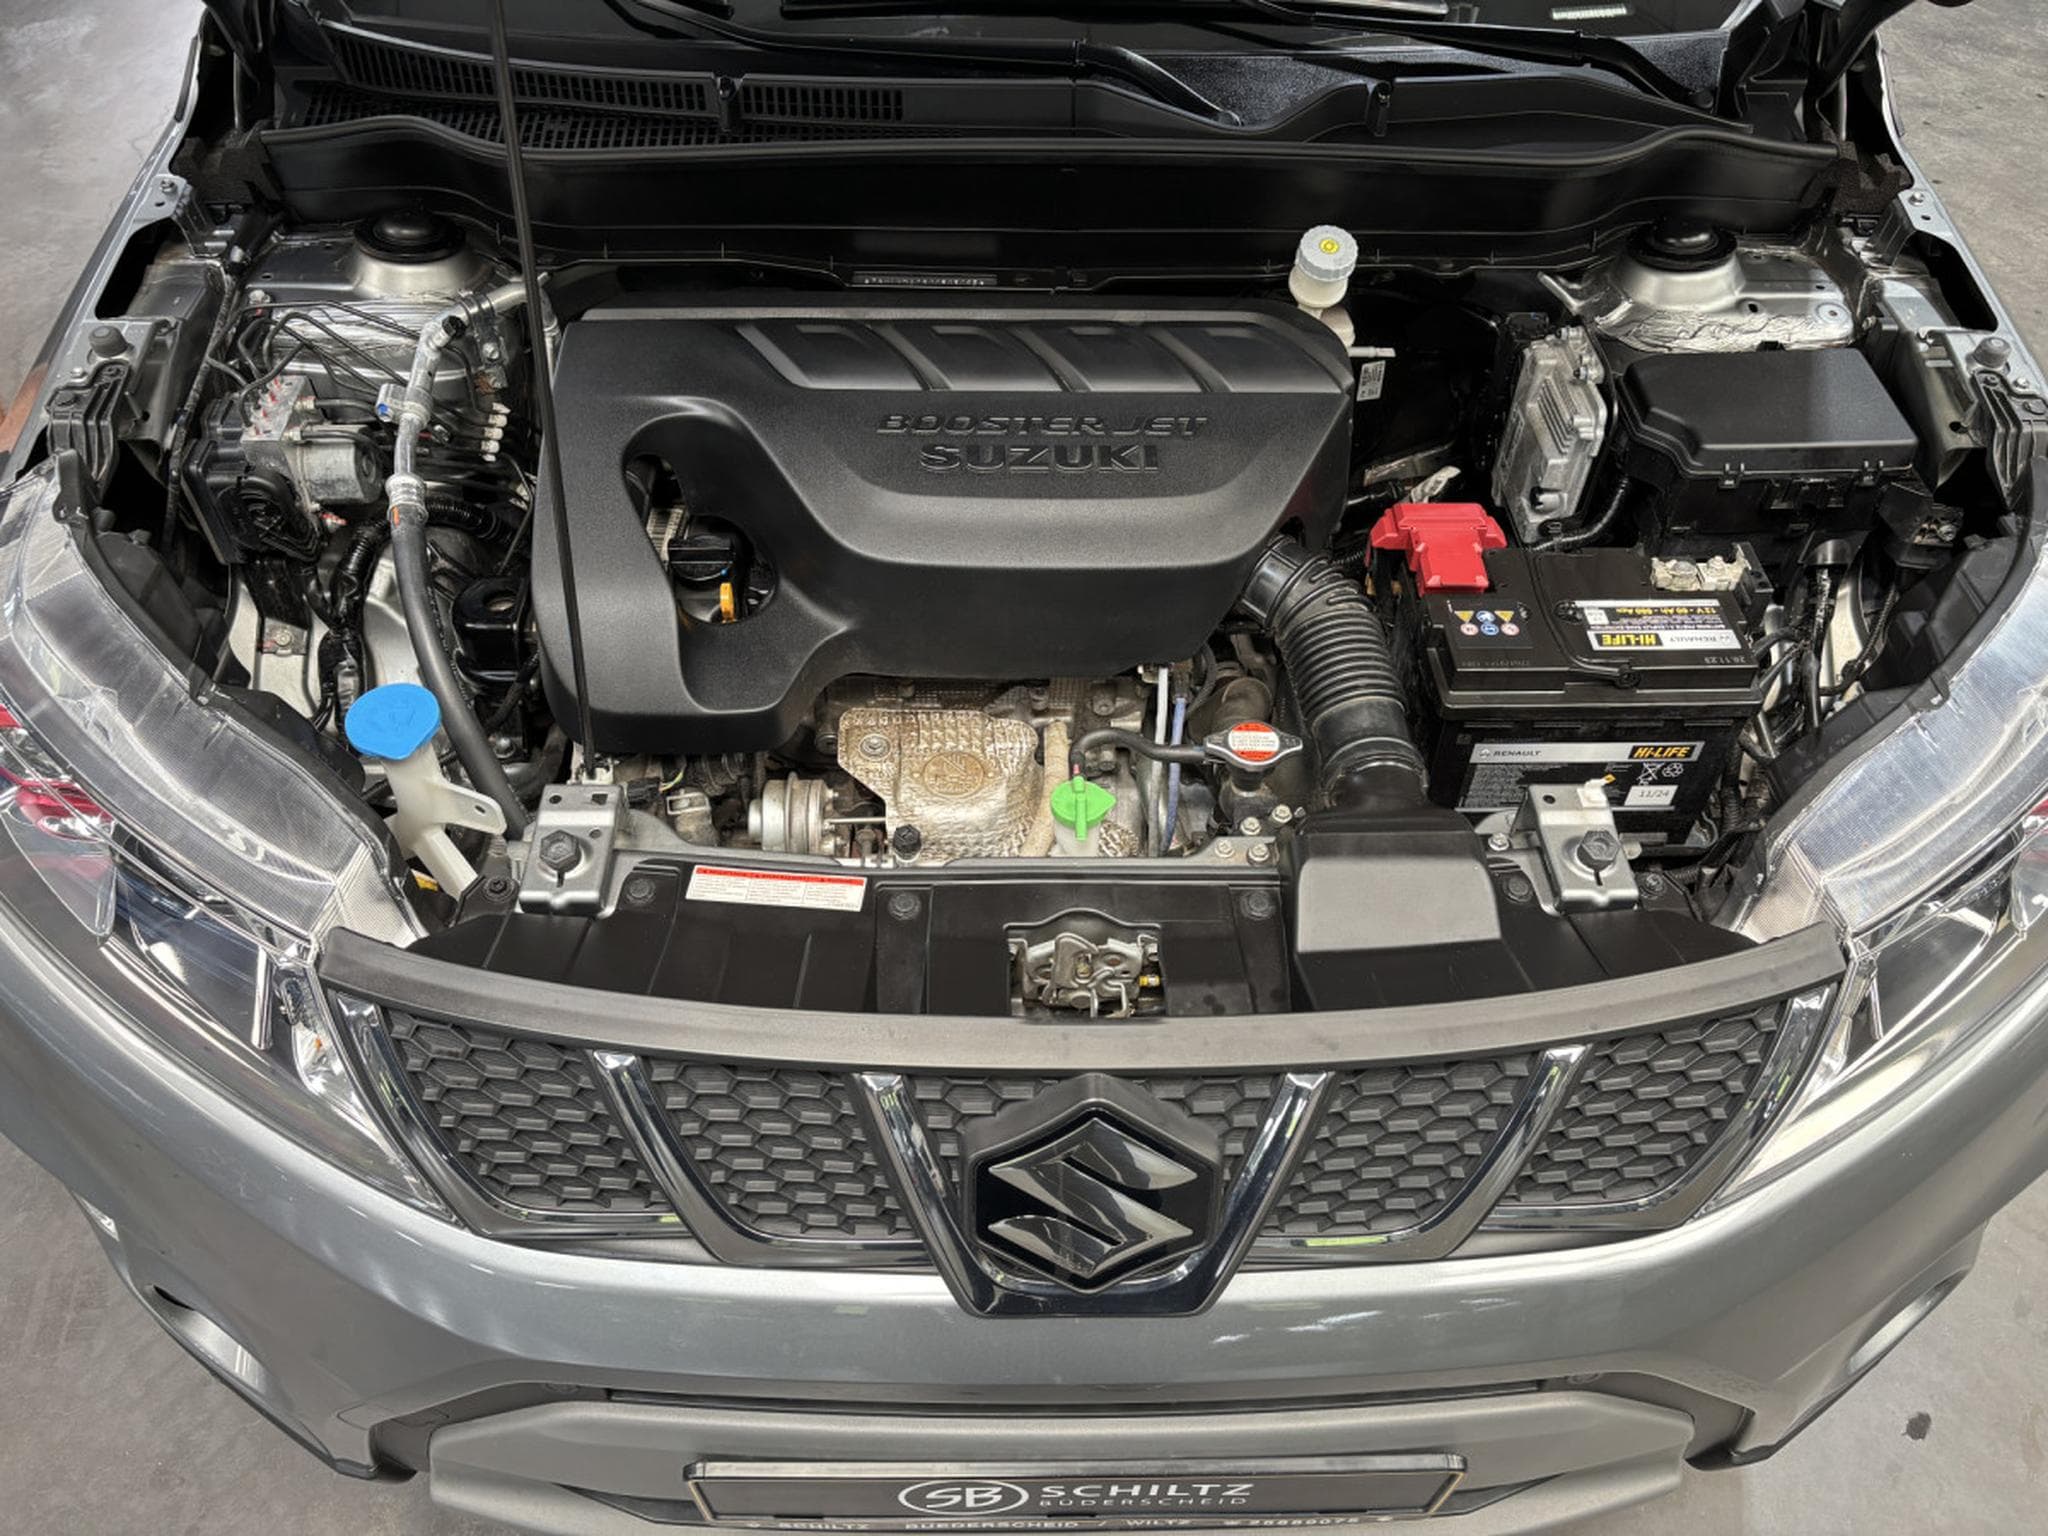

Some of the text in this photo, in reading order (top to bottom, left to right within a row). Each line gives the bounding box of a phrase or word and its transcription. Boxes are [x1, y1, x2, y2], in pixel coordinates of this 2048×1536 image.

[920, 444, 1160, 473] SUZUKI
[1493, 749, 1541, 757] RENAULT
[1639, 790, 1670, 798] 11/24
[1040, 1484, 1254, 1498] SCHILTZ
[926, 1488, 1003, 1508] SB
[777, 1521, 871, 1530] SCHILTZ
[1126, 1518, 1192, 1526] WILTZ
